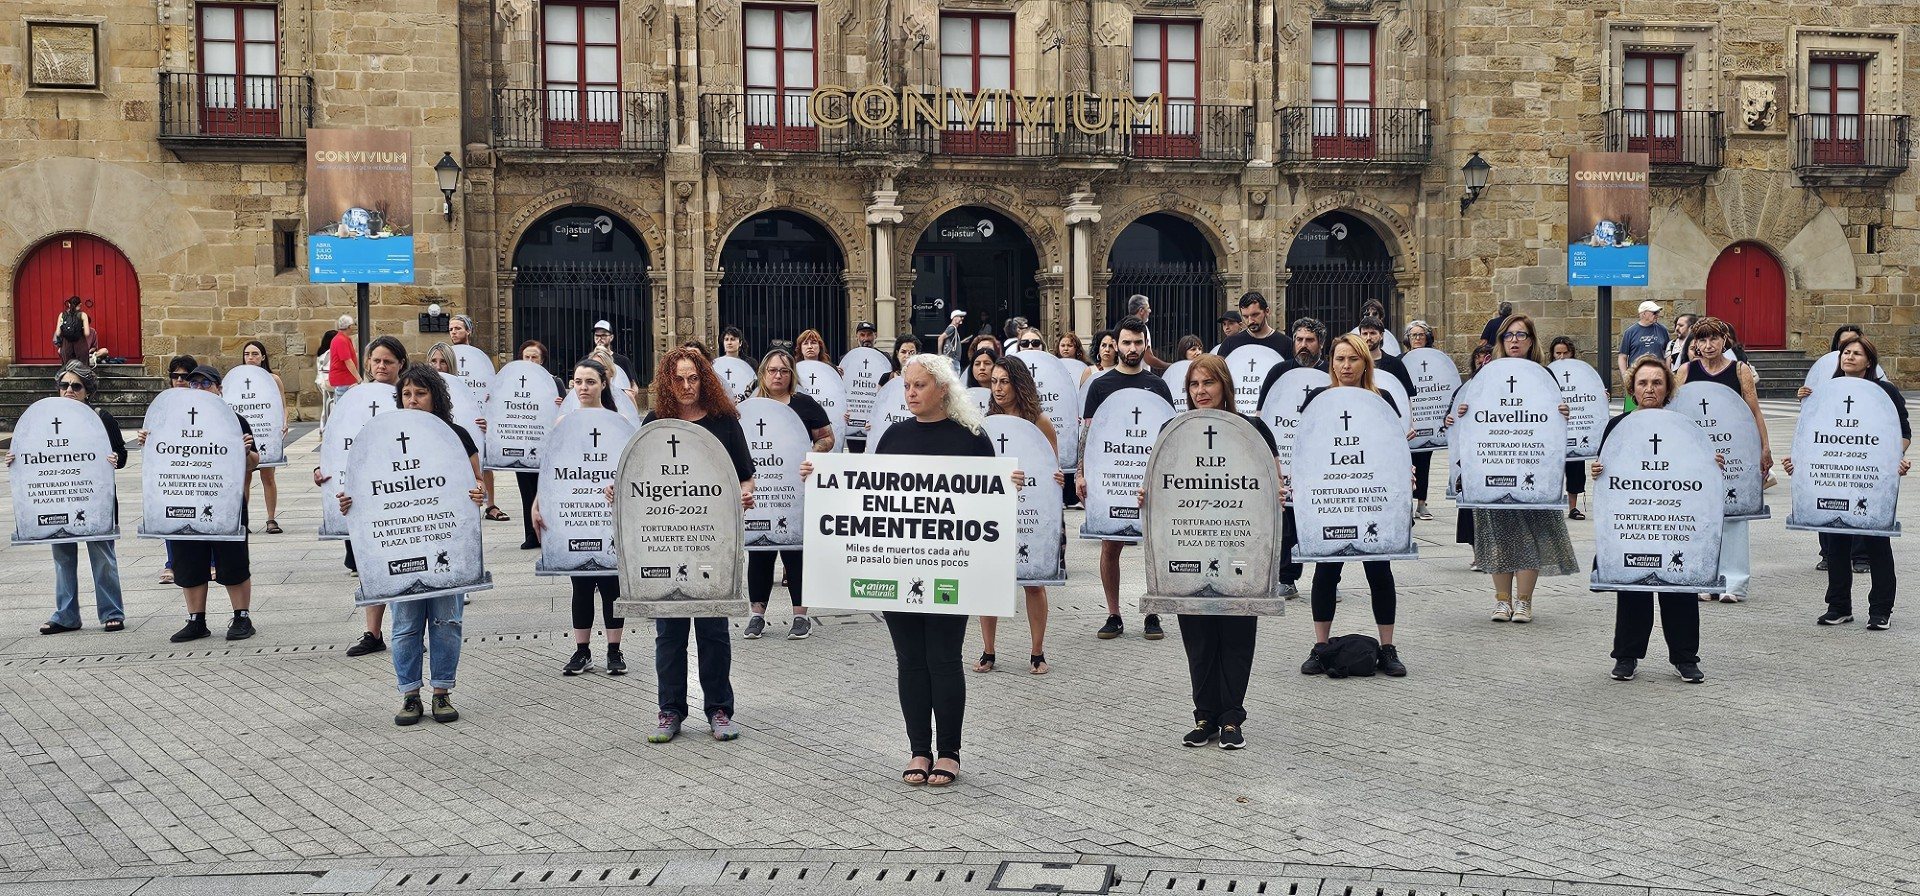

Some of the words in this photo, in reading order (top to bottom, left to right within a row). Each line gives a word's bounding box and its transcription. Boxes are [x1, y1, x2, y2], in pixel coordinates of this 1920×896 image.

[808, 84, 1163, 135] CONVIVIUM
[315, 151, 406, 163] CONVIVIUM
[1575, 170, 1645, 182] CONVIVIUM
[555, 225, 591, 235] Cajastur
[941, 229, 975, 239] Cajastur
[1298, 233, 1329, 241] Cajastur
[853, 380, 876, 388] Pitito
[228, 402, 272, 413] ogonero
[504, 401, 539, 411] Tostón
[1474, 410, 1548, 423] Clavellino
[1836, 419, 1859, 427] R.I.P.
[1126, 429, 1147, 438] R.I.P.
[1814, 431, 1879, 445] Inocente
[47, 439, 69, 447] R.I.P.
[1334, 436, 1360, 446] R.I.P.
[156, 442, 228, 458] Gorgonito
[1104, 441, 1152, 455] Batane
[21, 452, 96, 464] Tabernero
[584, 453, 608, 462] R.I.P.
[1330, 450, 1365, 465] Leal
[1823, 451, 1868, 460] 2021-2025
[392, 459, 420, 472] R.I.P.
[1196, 456, 1226, 467] R.I.P.
[1642, 461, 1669, 470] R.I.P.
[554, 467, 618, 483] Malague
[661, 465, 689, 475] R.I.P.
[371, 475, 446, 496] Fusilero
[817, 473, 839, 489] LA
[844, 471, 1005, 495] TAUROMAQUIA
[1162, 473, 1260, 490] Feminista
[1609, 476, 1702, 491] Rencoroso
[631, 480, 722, 502] Nigeriano
[384, 497, 439, 510] 2020-2025
[863, 495, 955, 514] ENLLENA
[1178, 500, 1243, 510] 2017-2021
[1628, 498, 1682, 508] 2021-2025
[646, 504, 707, 515] 2016-2021
[372, 515, 425, 528] TORTURADO
[427, 511, 455, 521] HASTA
[386, 526, 422, 536] MUERTE
[820, 514, 999, 542] CEMENTERIOS
[381, 538, 408, 548] PLAZA
[410, 536, 421, 544] DE
[422, 532, 452, 542] TOROS
[846, 543, 870, 552] Miles
[872, 545, 884, 553] de
[886, 546, 925, 555] muertos
[928, 547, 950, 556] cada
[952, 548, 970, 556] añu
[402, 560, 424, 568] anima
[860, 555, 891, 564] pasalo
[894, 556, 913, 564] bien
[867, 582, 895, 591] anima
